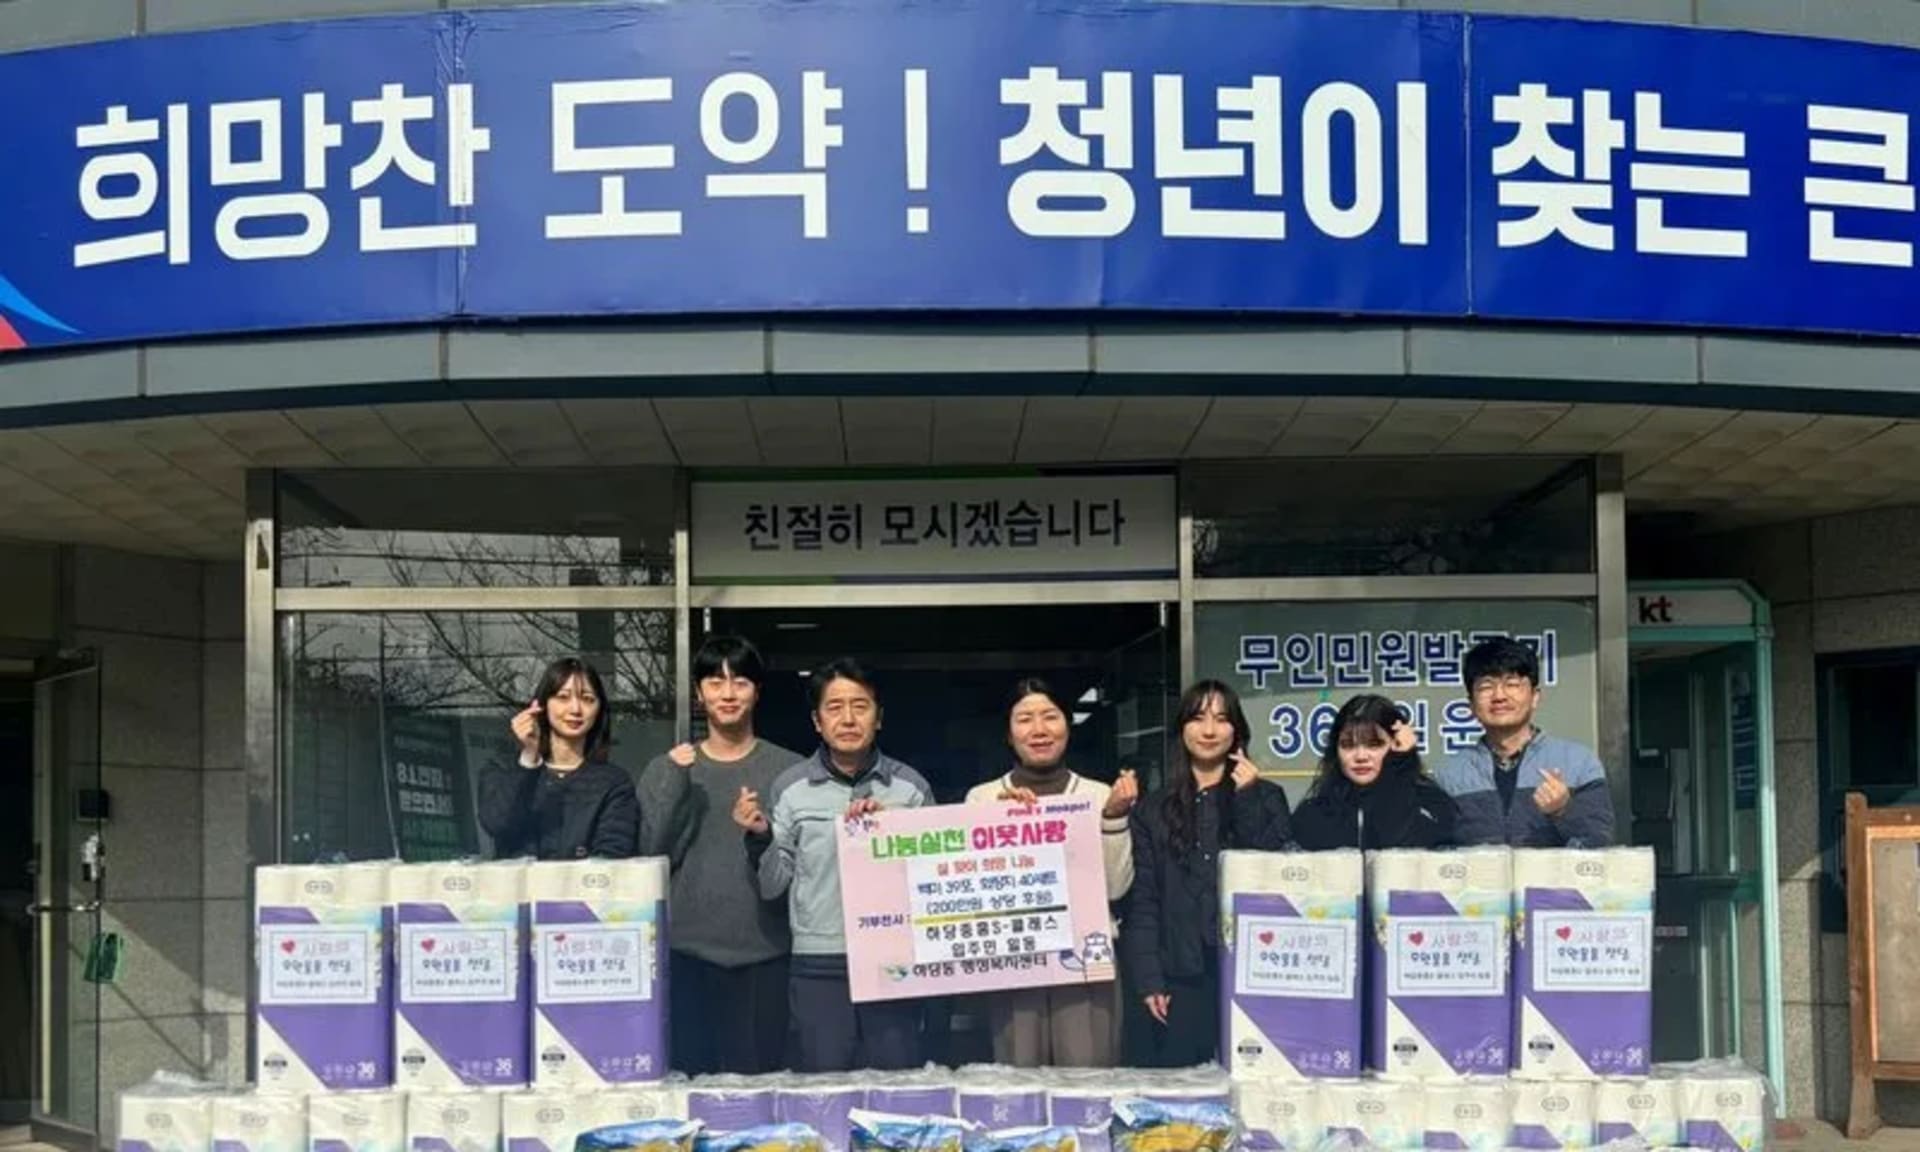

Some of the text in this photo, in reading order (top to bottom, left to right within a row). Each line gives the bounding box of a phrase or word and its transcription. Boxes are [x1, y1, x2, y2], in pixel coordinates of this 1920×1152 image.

[74, 66, 1915, 267] 희망찬 도약 ! 청년이 찾는 큰
[743, 498, 1126, 552] 친절히 모시겠습니다
[1639, 597, 1673, 623] kt
[1236, 630, 1558, 688] 무인민원발기
[871, 820, 1067, 859] 나눔실천 이웃사랑
[912, 952, 1048, 977] 하당동 행정복지센터
[952, 936, 1036, 958] 입주민 일동
